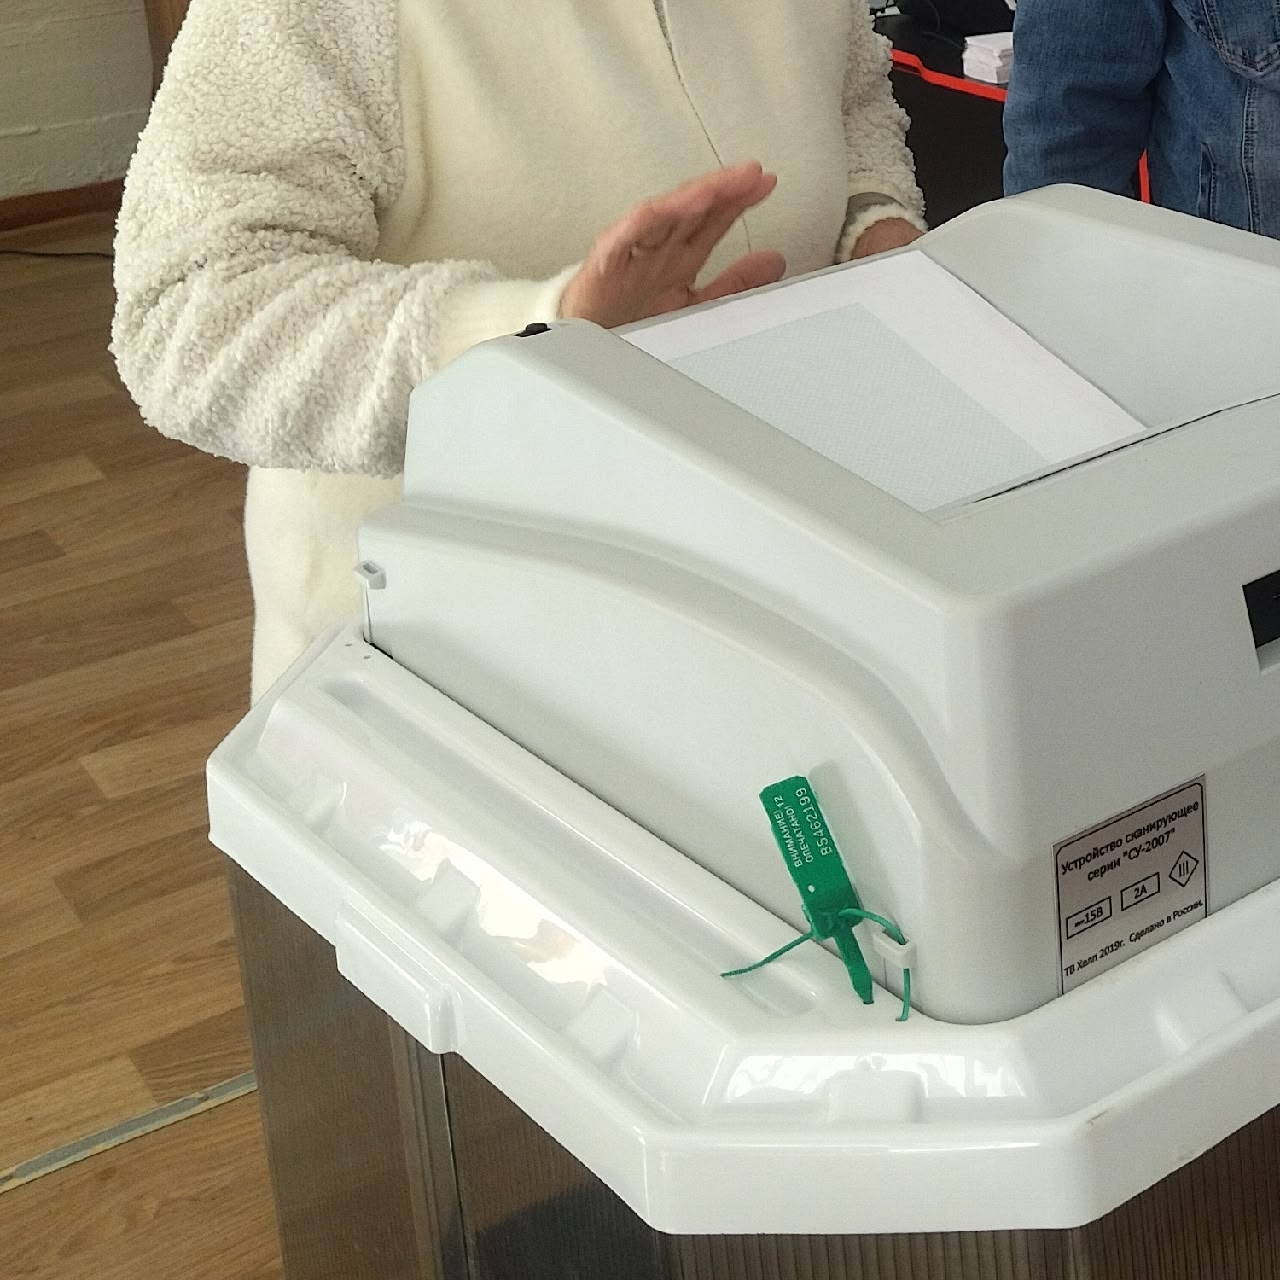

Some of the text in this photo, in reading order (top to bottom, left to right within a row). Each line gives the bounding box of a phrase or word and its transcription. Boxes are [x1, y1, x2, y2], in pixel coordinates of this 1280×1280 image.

[773, 810, 803, 868] ВНИМАНИЕ!
[784, 805, 814, 863] ОПЕЧАТАНО!
[1061, 801, 1199, 875] Устройство сканирующее
[1087, 827, 1175, 881] серии "СУ-2007"
[1129, 920, 1164, 943] Сделано
